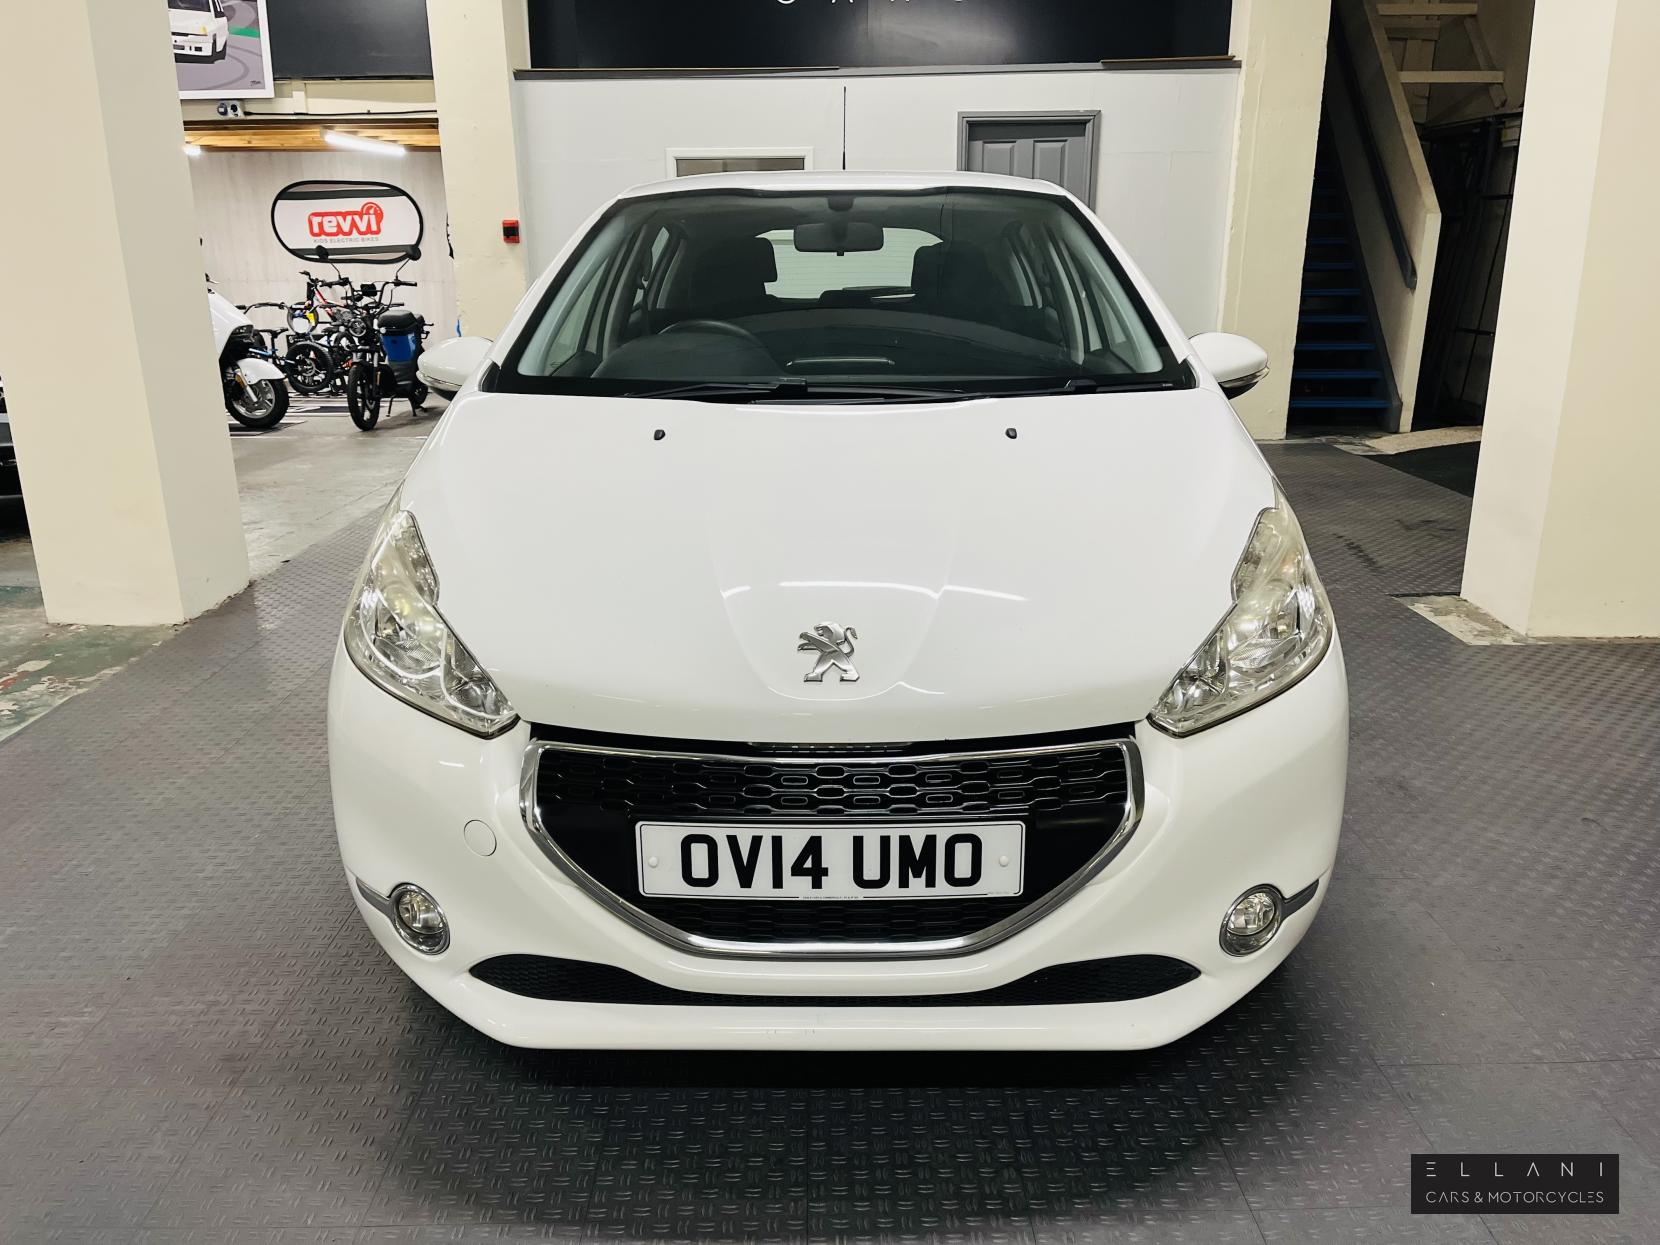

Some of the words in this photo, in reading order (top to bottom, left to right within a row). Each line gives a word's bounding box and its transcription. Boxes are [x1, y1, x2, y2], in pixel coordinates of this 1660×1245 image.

[309, 205, 379, 234] revvi
[680, 834, 829, 889] OV14
[853, 833, 983, 889] UMO
